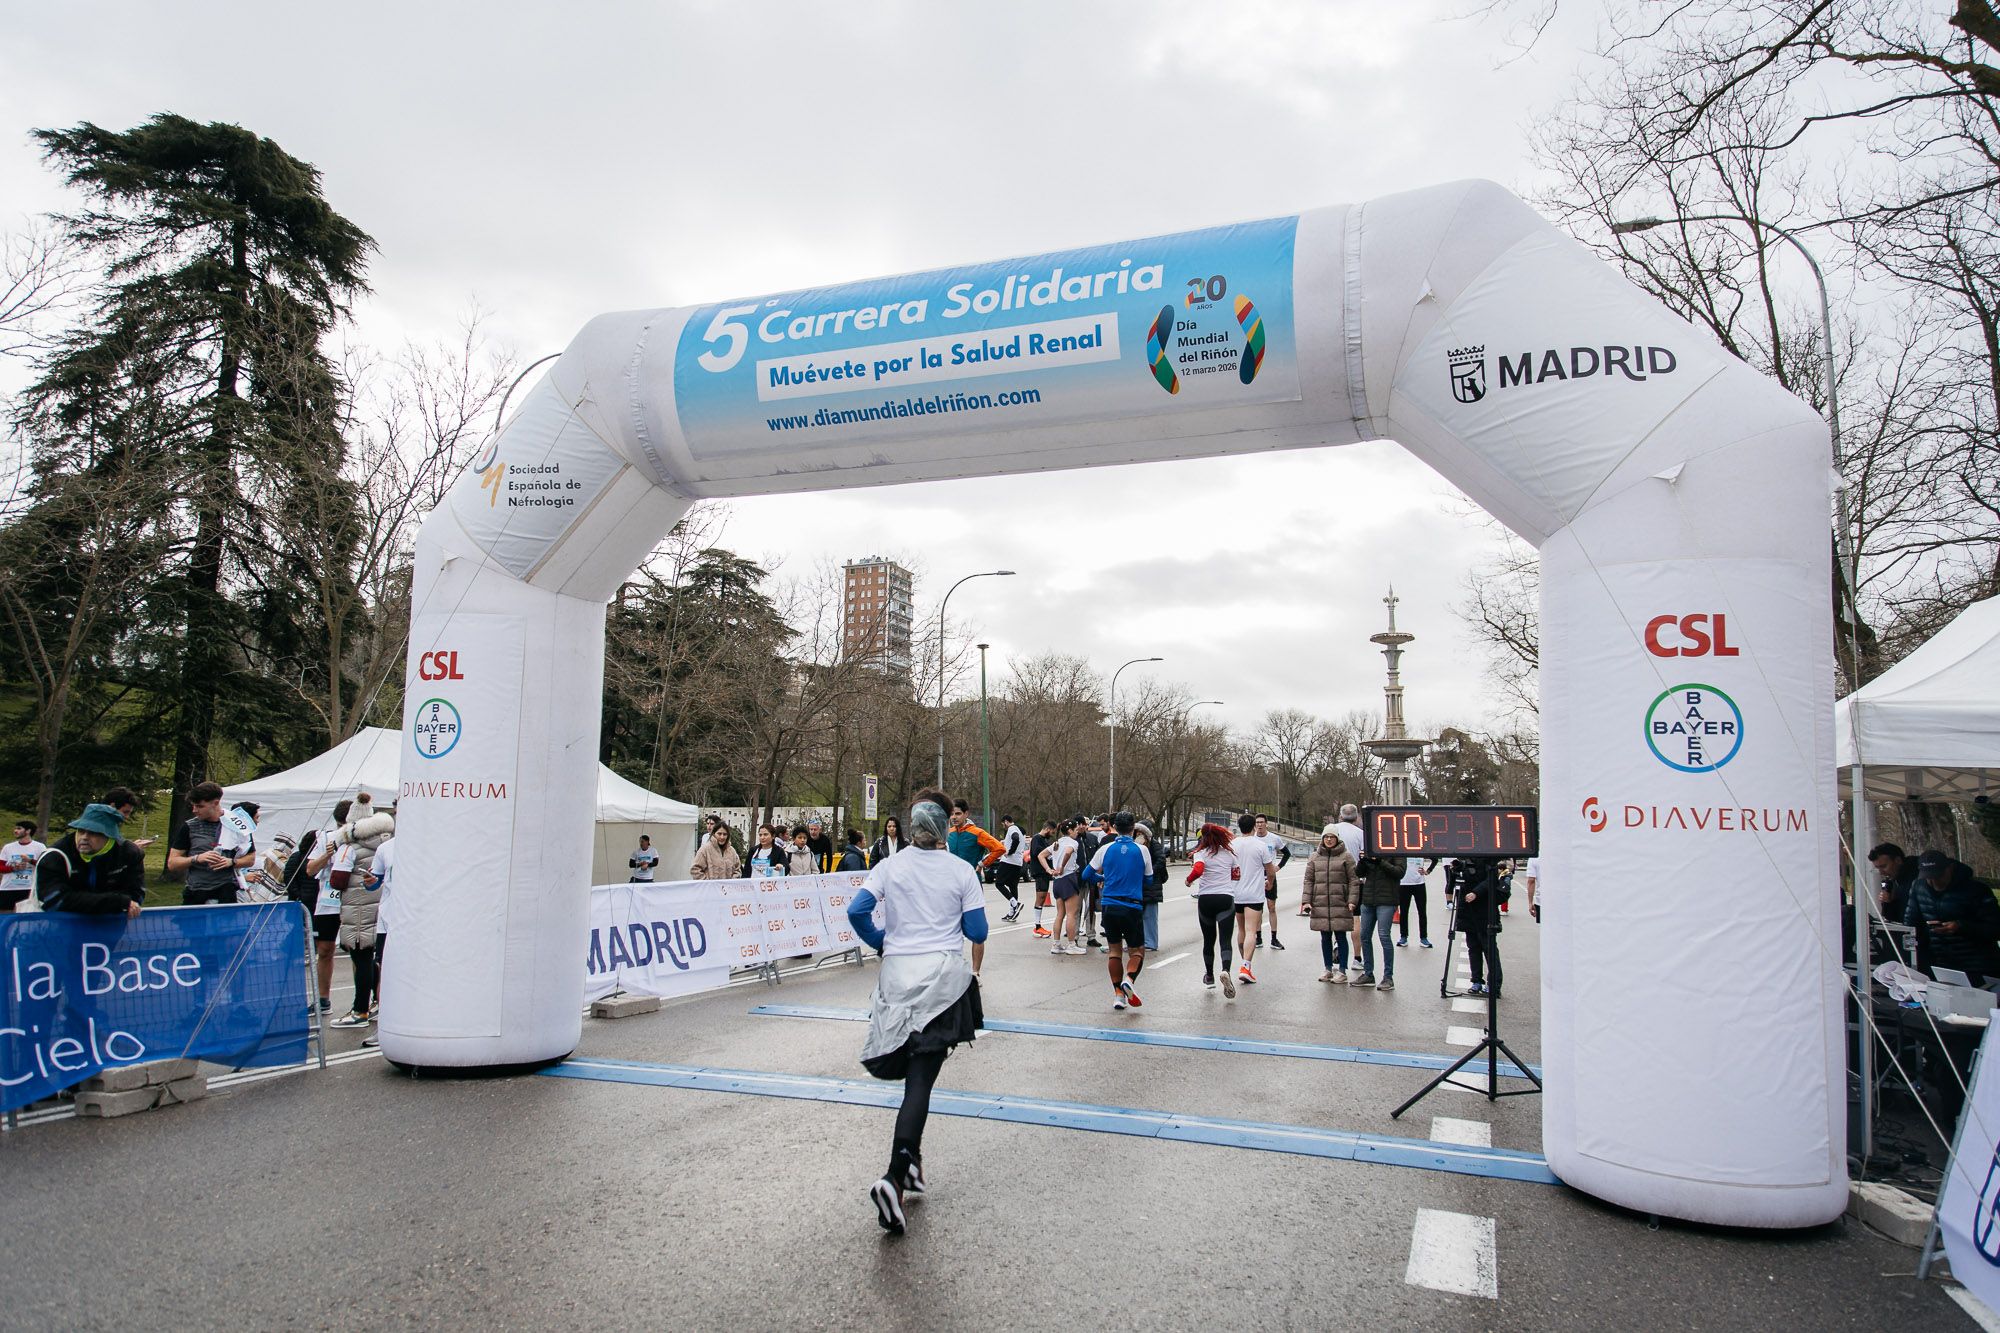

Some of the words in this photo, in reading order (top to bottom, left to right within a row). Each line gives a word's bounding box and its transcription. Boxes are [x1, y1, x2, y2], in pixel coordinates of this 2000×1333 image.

[1186, 275, 1227, 305] 20
[758, 299, 928, 343] Carrera
[942, 259, 1164, 318] Solidaria
[1196, 303, 1213, 311] AÑOS
[1176, 321, 1197, 332] Día
[1177, 331, 1229, 348] Mundial
[769, 360, 866, 388] Muévete
[874, 356, 913, 381] por
[920, 347, 943, 369] la
[951, 335, 1020, 365] Salud
[1029, 324, 1103, 355] Renal
[1179, 352, 1199, 364] del
[1201, 347, 1238, 361] Riñón
[1181, 368, 1191, 376] 12
[1192, 366, 1217, 376] marzo
[1218, 362, 1238, 373] 2026
[1498, 345, 1677, 389] MADRID
[766, 386, 1041, 432] www.diamundialdelriñon.com
[509, 463, 560, 475] Sociedad
[508, 480, 561, 493] Española
[566, 479, 582, 490] de
[508, 496, 574, 509] Nefrología
[1644, 613, 1740, 658] CSL
[419, 650, 464, 682] CSL
[416, 722, 456, 734] BAYER
[428, 704, 440, 754] BAYER
[1653, 721, 1736, 735] BAYER
[1686, 691, 1704, 766] BAYER
[403, 782, 507, 799] DIAVERUM
[230, 816, 247, 830] 409
[1624, 805, 1809, 832] DIAVERUM
[760, 880, 779, 892] GSK
[732, 904, 752, 917] GSK
[794, 898, 811, 910] GSK
[830, 896, 846, 907] GSK
[768, 919, 786, 932] GSK
[838, 930, 854, 942] GSK
[587, 917, 707, 975] MADRID
[740, 944, 760, 958] GSK
[802, 934, 820, 948] GSK
[13, 947, 62, 1002] la
[82, 942, 201, 996] Base
[0, 1017, 146, 1087] Cielo
